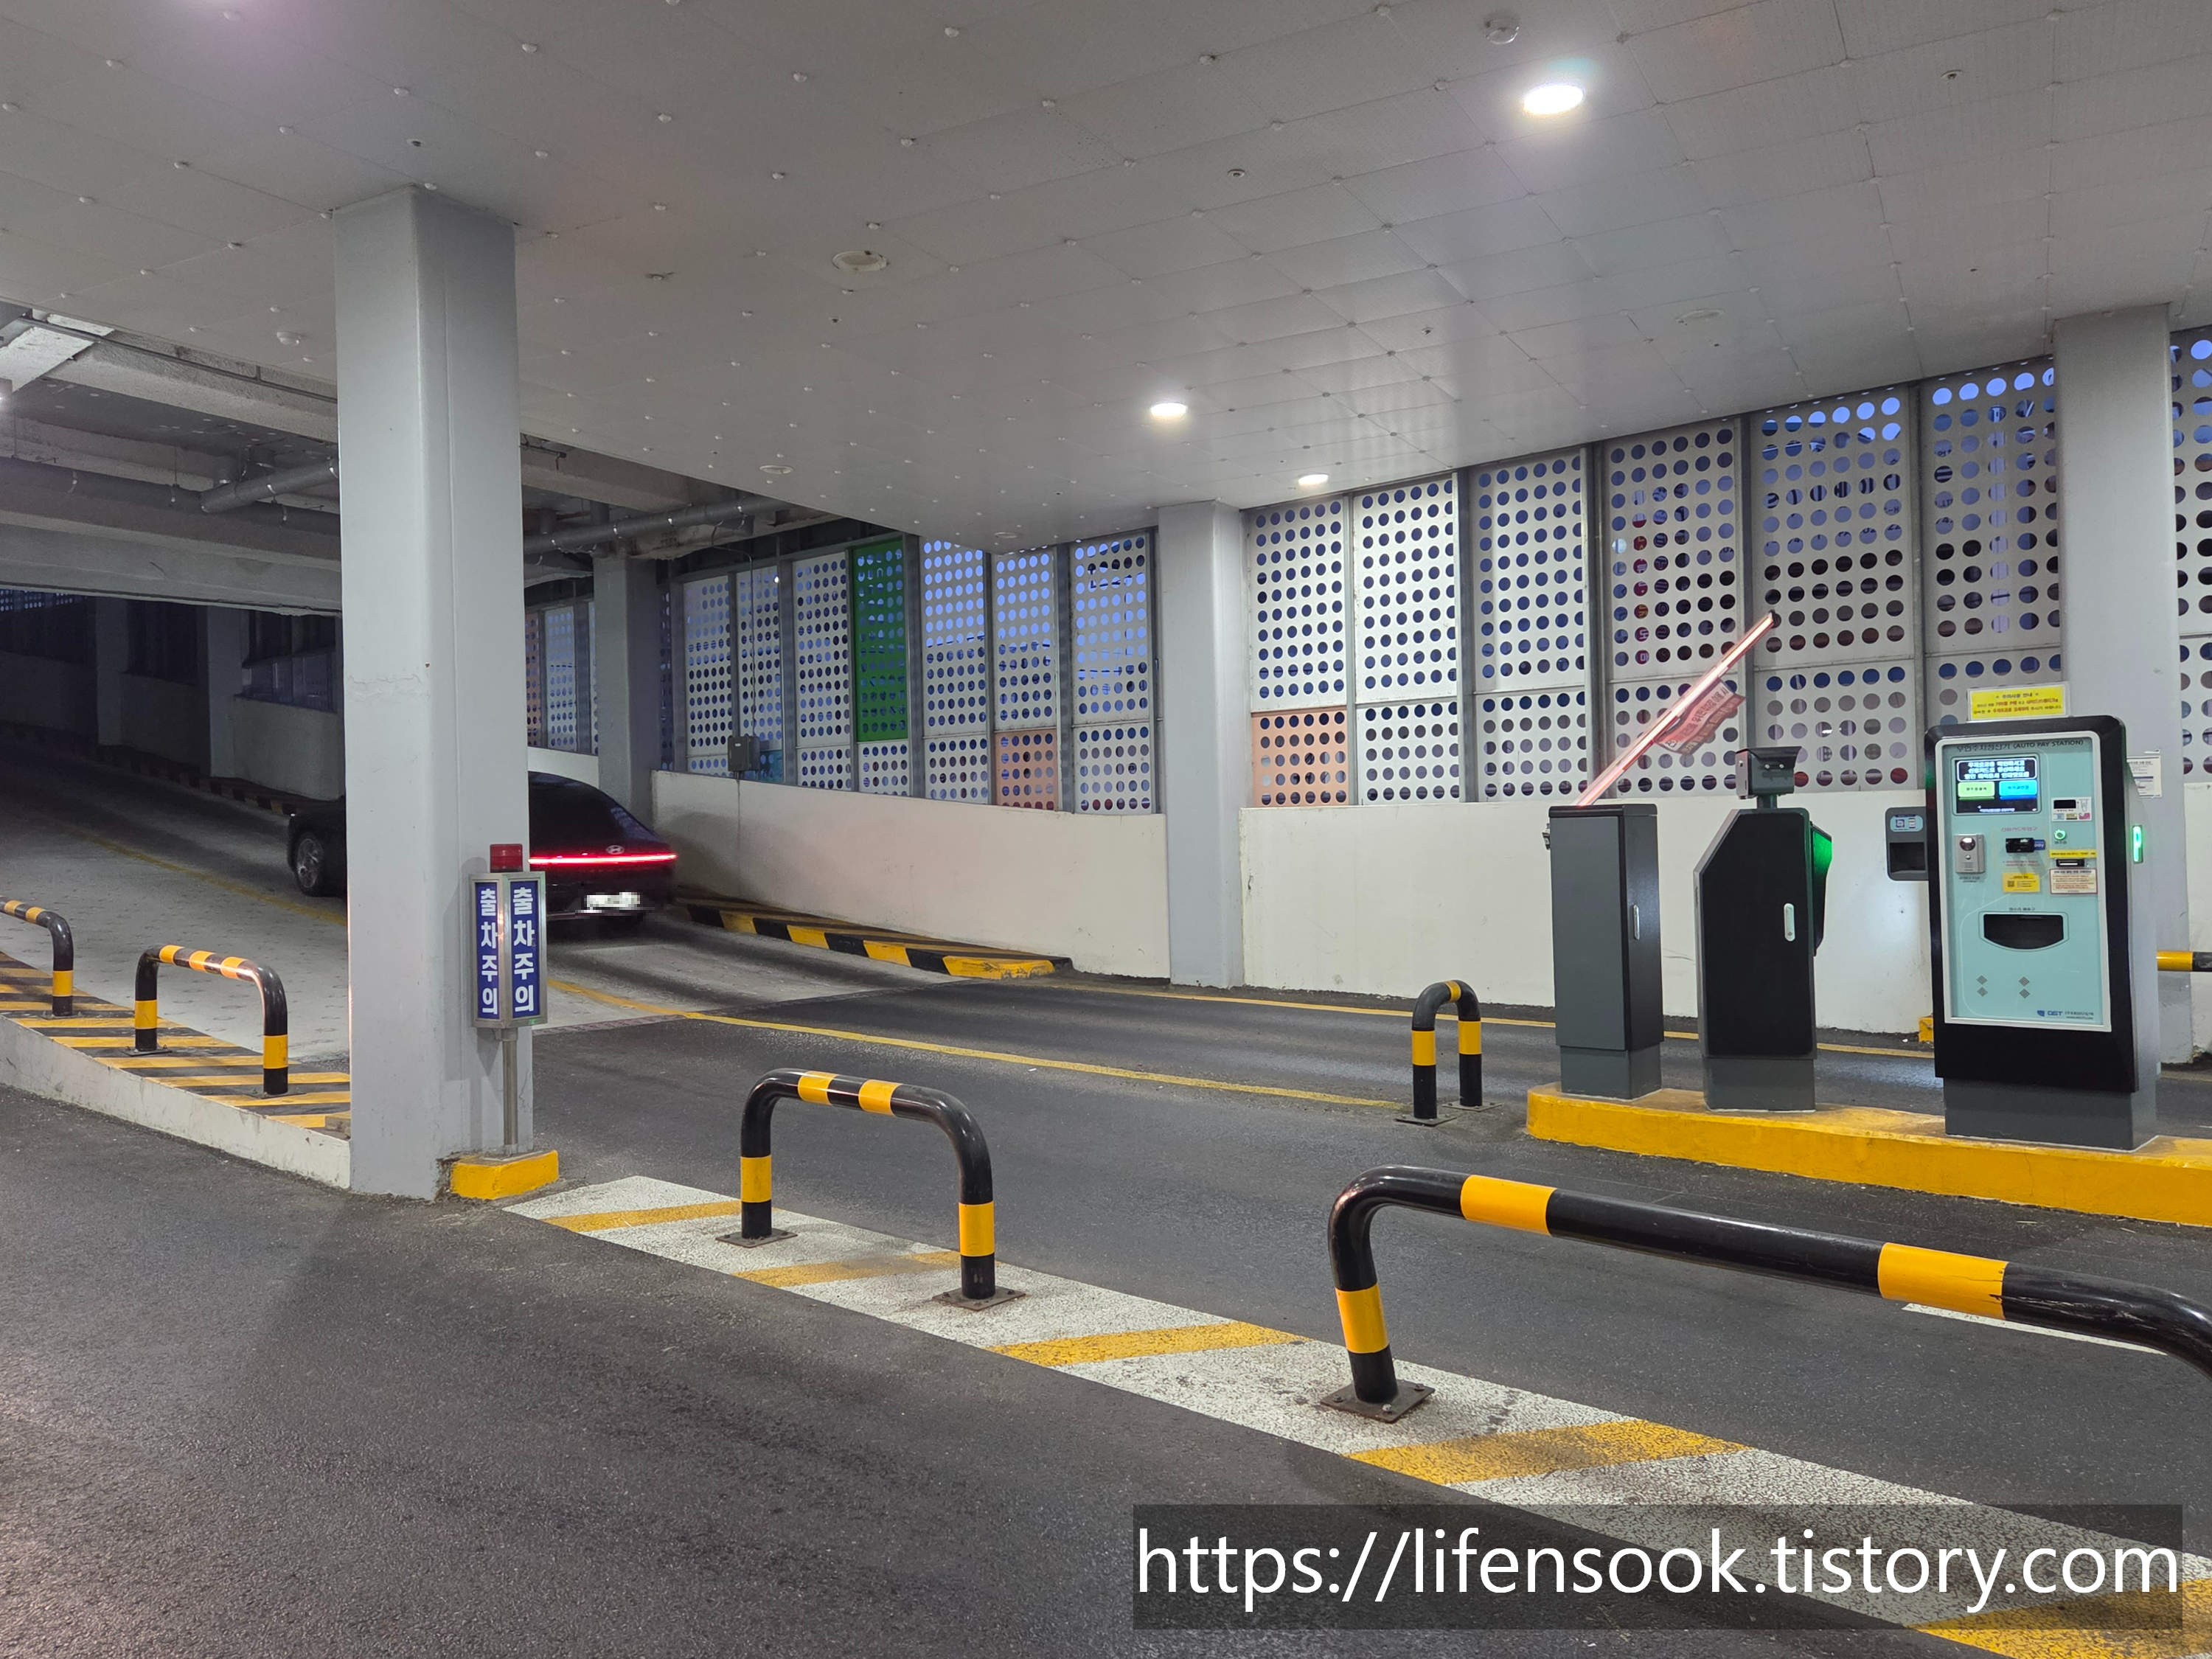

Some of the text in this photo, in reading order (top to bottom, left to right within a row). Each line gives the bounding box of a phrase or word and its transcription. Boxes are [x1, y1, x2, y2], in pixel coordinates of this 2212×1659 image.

[2013, 742, 2036, 750] (AUTO
[480, 888, 498, 1015] 출차주의
[512, 887, 535, 1012] 출차주의
